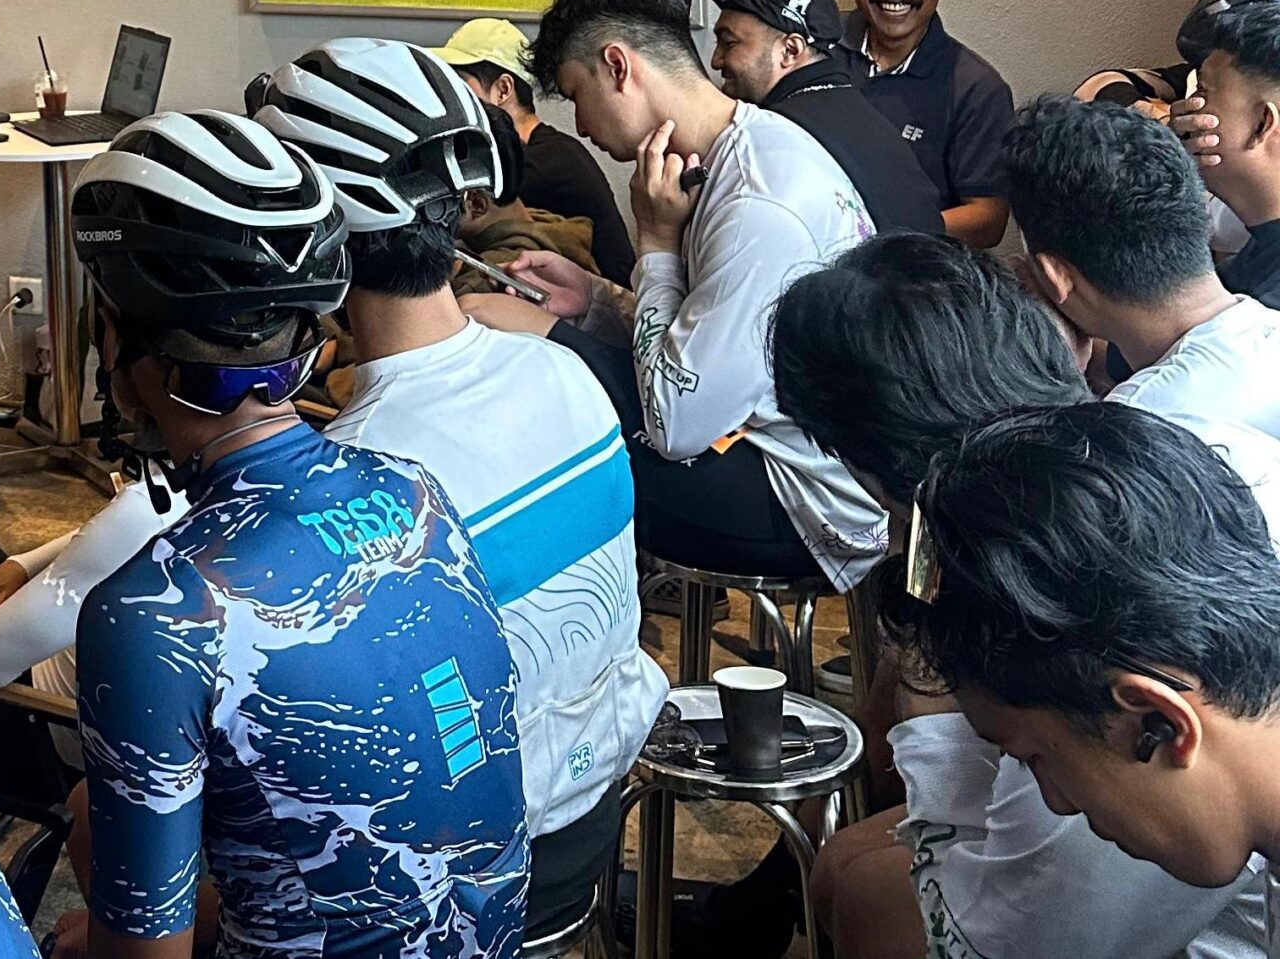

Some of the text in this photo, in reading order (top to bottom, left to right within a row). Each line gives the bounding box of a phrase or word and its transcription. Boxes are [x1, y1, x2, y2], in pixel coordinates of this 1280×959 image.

[76, 230, 122, 241] ROCKBROS
[676, 373, 693, 386] UP
[352, 531, 403, 563] TEAM
